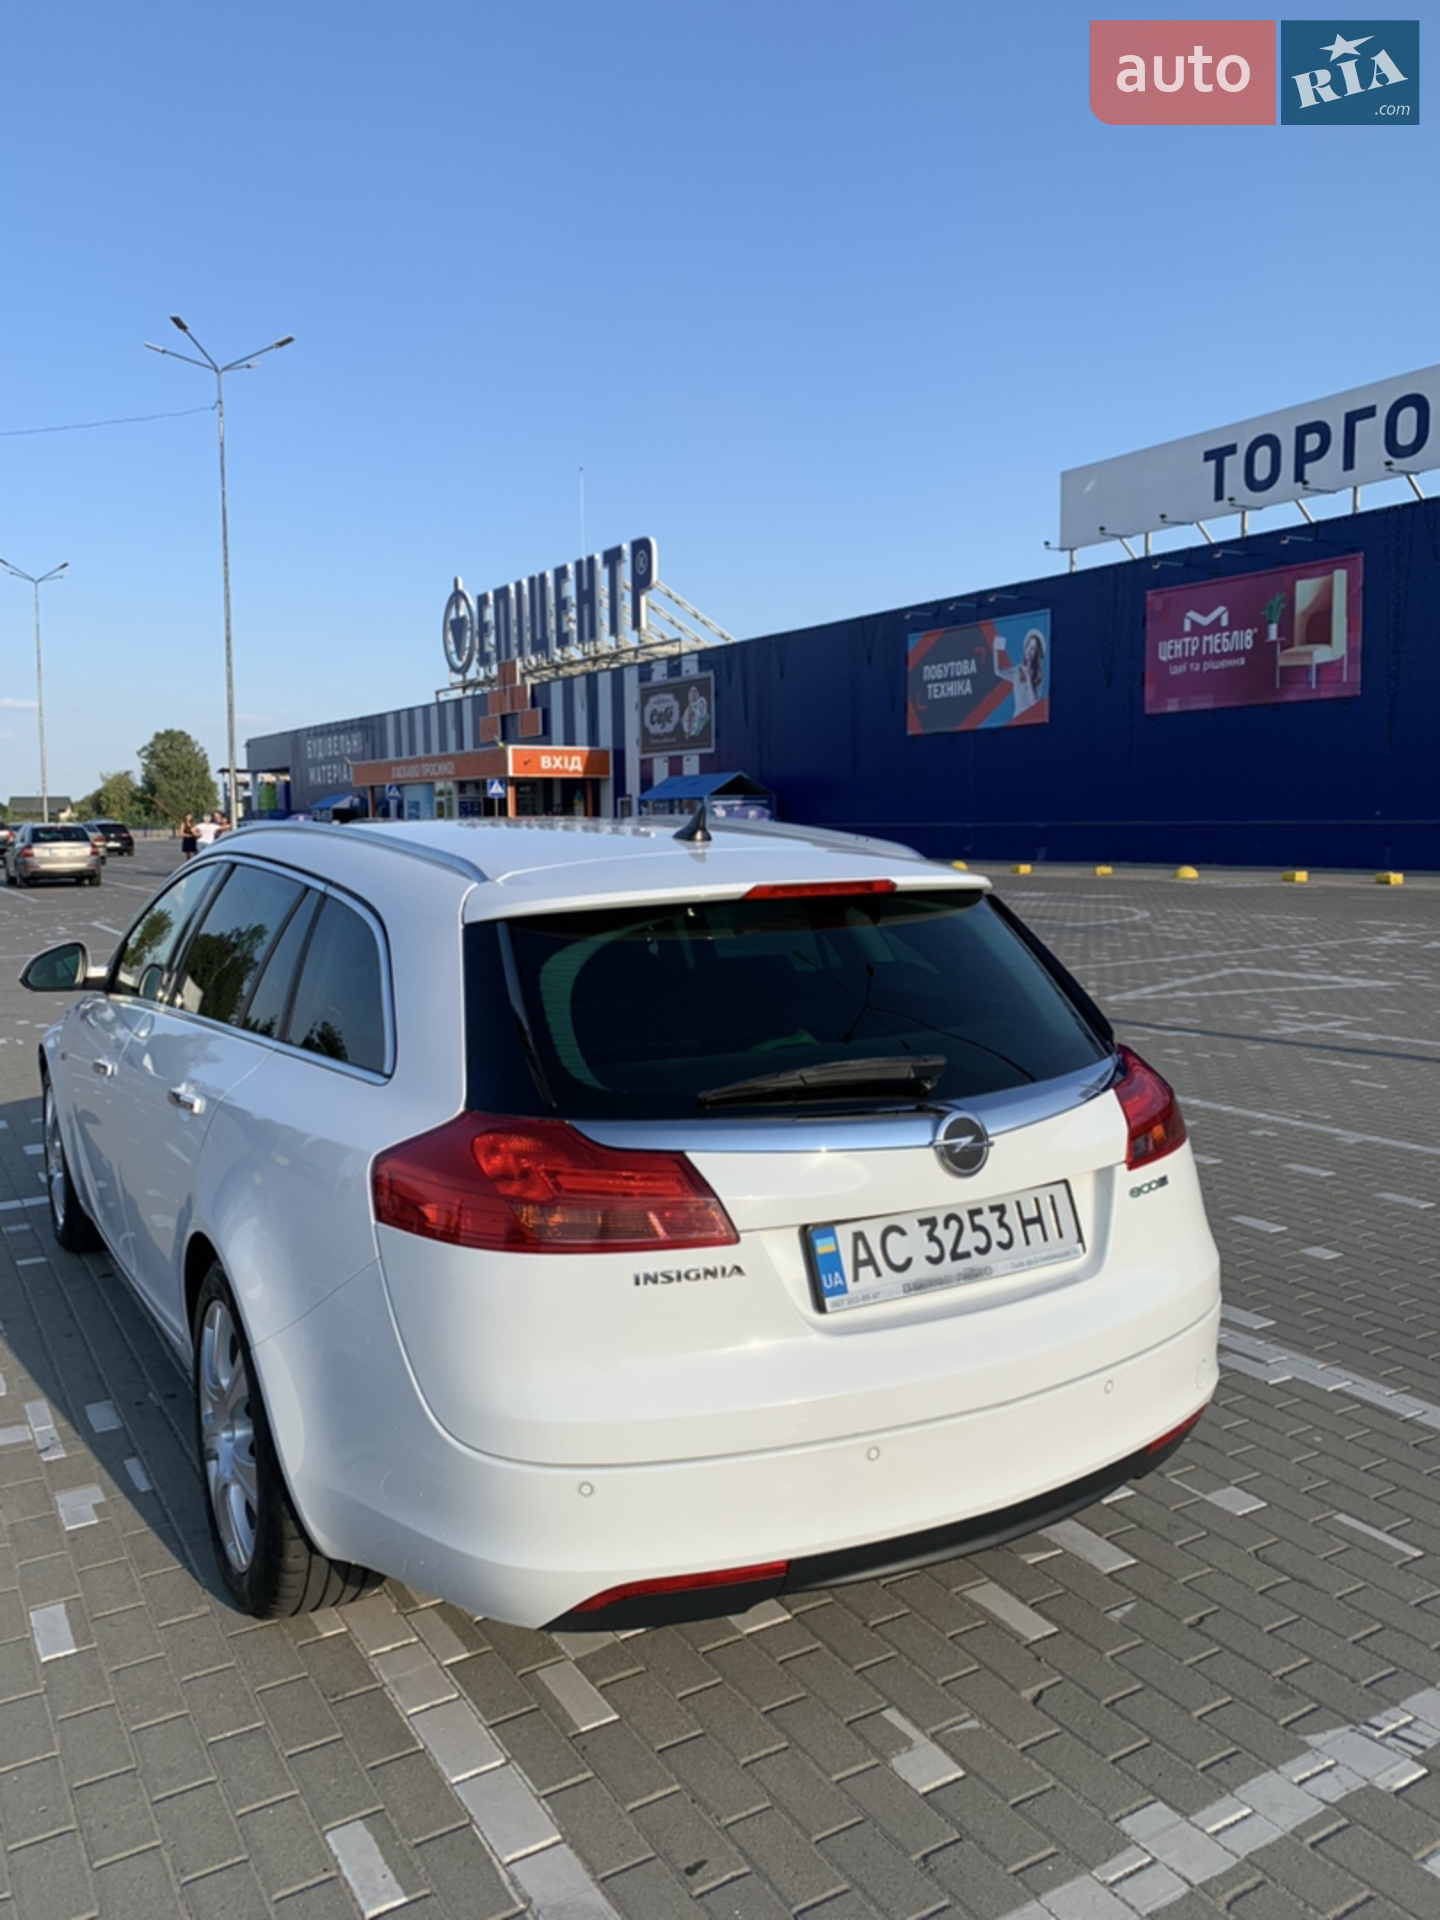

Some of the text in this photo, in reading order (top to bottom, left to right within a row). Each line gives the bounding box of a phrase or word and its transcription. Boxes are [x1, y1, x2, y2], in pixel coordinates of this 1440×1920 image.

[1203, 393, 1431, 502] ТОРГО
[476, 536, 658, 668] ЕПІЦЕНТР
[1158, 628, 1254, 662] ЦЕНТР МЕБЛІВ
[923, 658, 977, 681] ПОБУТОВА
[927, 679, 973, 699] ТЕХНІКА
[540, 755, 583, 772] ВХІД
[851, 1224, 914, 1284] AC
[917, 1203, 1015, 1266] 3253
[1015, 1193, 1064, 1247] HI
[633, 1264, 747, 1288] INSIGNIA
[822, 1272, 846, 1291] UA
